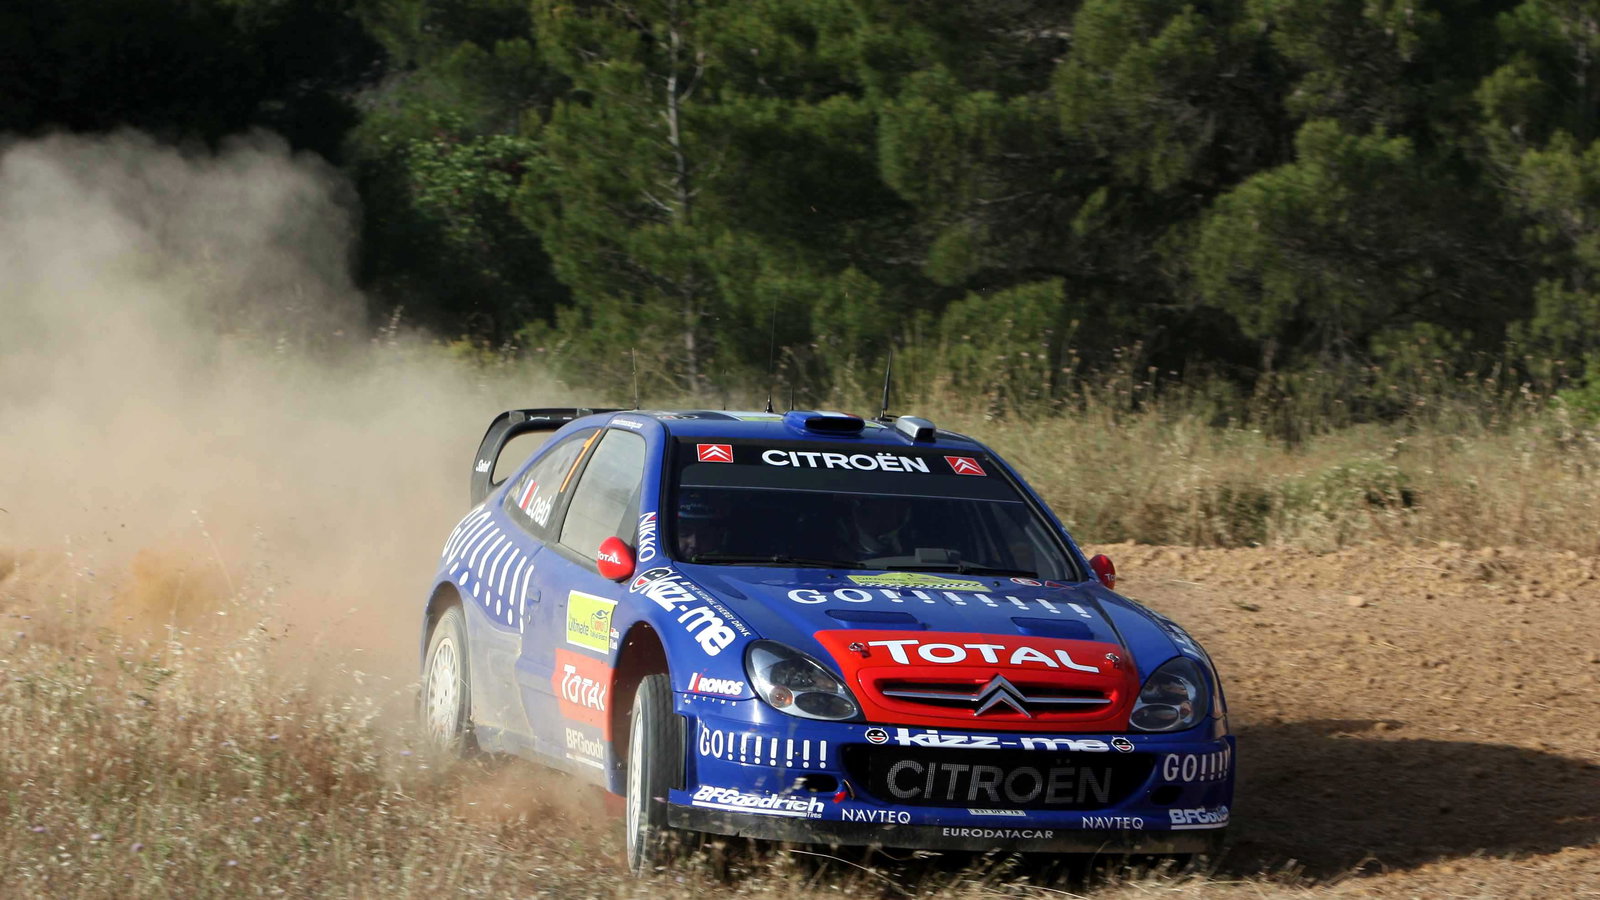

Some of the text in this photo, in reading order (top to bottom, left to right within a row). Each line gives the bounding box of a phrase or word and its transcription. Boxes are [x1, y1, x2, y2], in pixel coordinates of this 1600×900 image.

[761, 449, 931, 473] CITROËN
[525, 485, 553, 529] Loeb
[639, 511, 657, 563] NIKKO
[597, 551, 621, 565] TOTAL
[731, 620, 752, 637] DRINK
[867, 639, 1099, 674] TOTAL
[687, 671, 745, 696] KRONOS
[683, 693, 737, 707] RACING
[894, 727, 1111, 753] kizz-me
[886, 757, 1113, 805] CITROËN
[693, 785, 825, 814] BFGoodrich
[842, 808, 912, 825] NAVTEQ
[1082, 816, 1145, 831] NAVTEQ
[942, 827, 1054, 839] EURODATACAR
